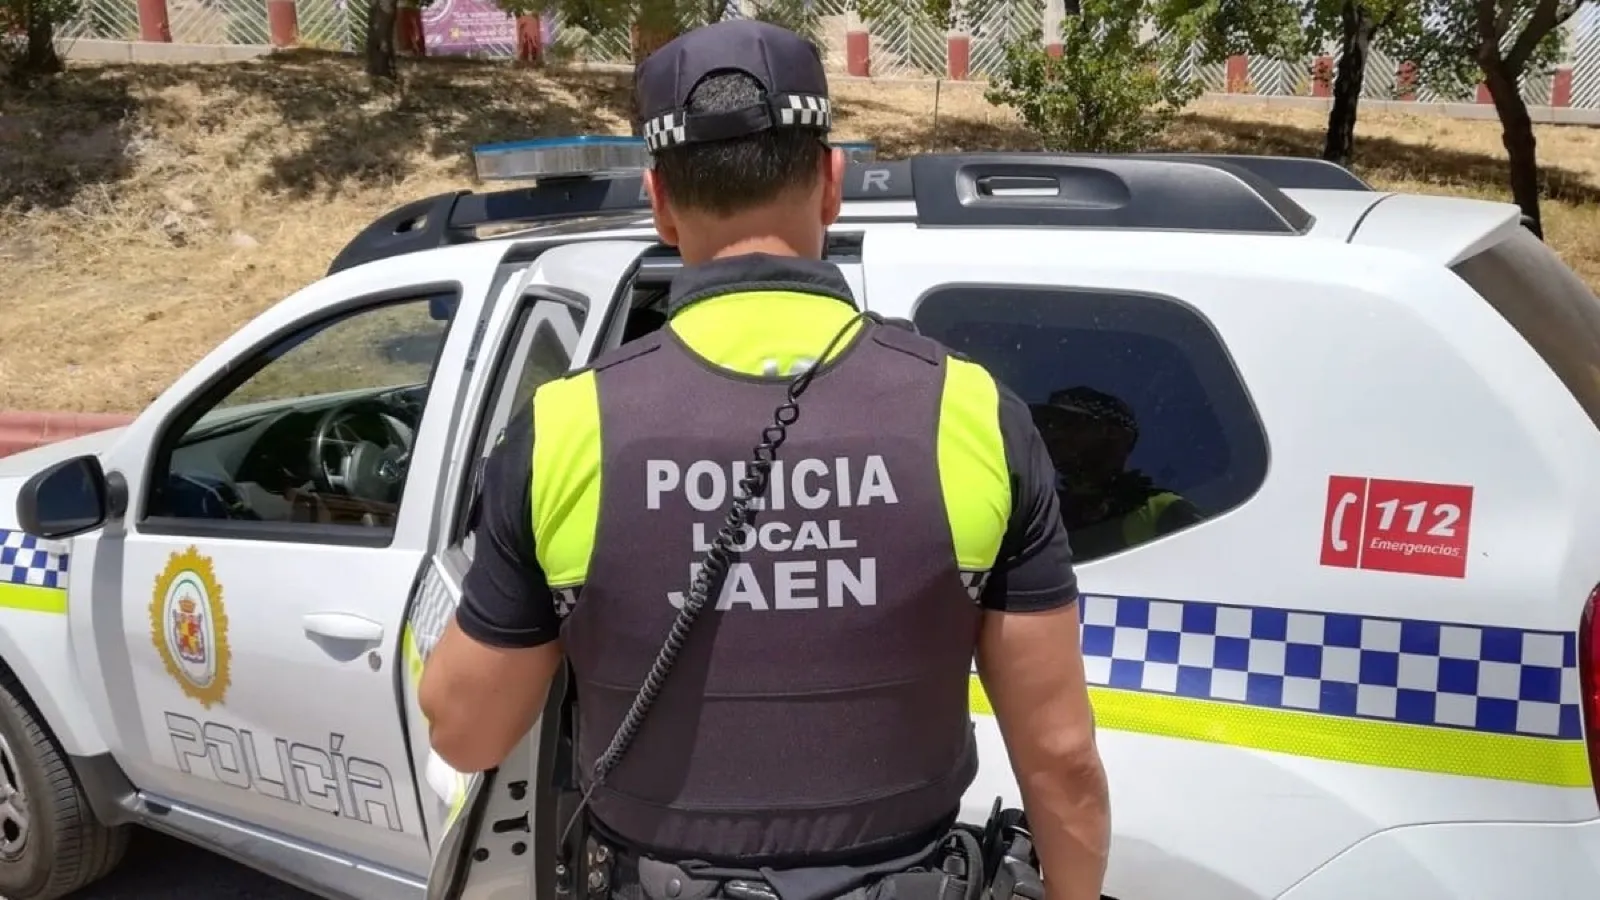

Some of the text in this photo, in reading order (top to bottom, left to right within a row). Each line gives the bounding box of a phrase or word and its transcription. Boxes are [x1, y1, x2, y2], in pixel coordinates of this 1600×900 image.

[646, 455, 899, 511] POLICIA
[692, 519, 858, 552] LOCAL
[1375, 498, 1461, 537] 112
[1370, 536, 1462, 557] Emergencias
[164, 711, 404, 832] POLICÍA
